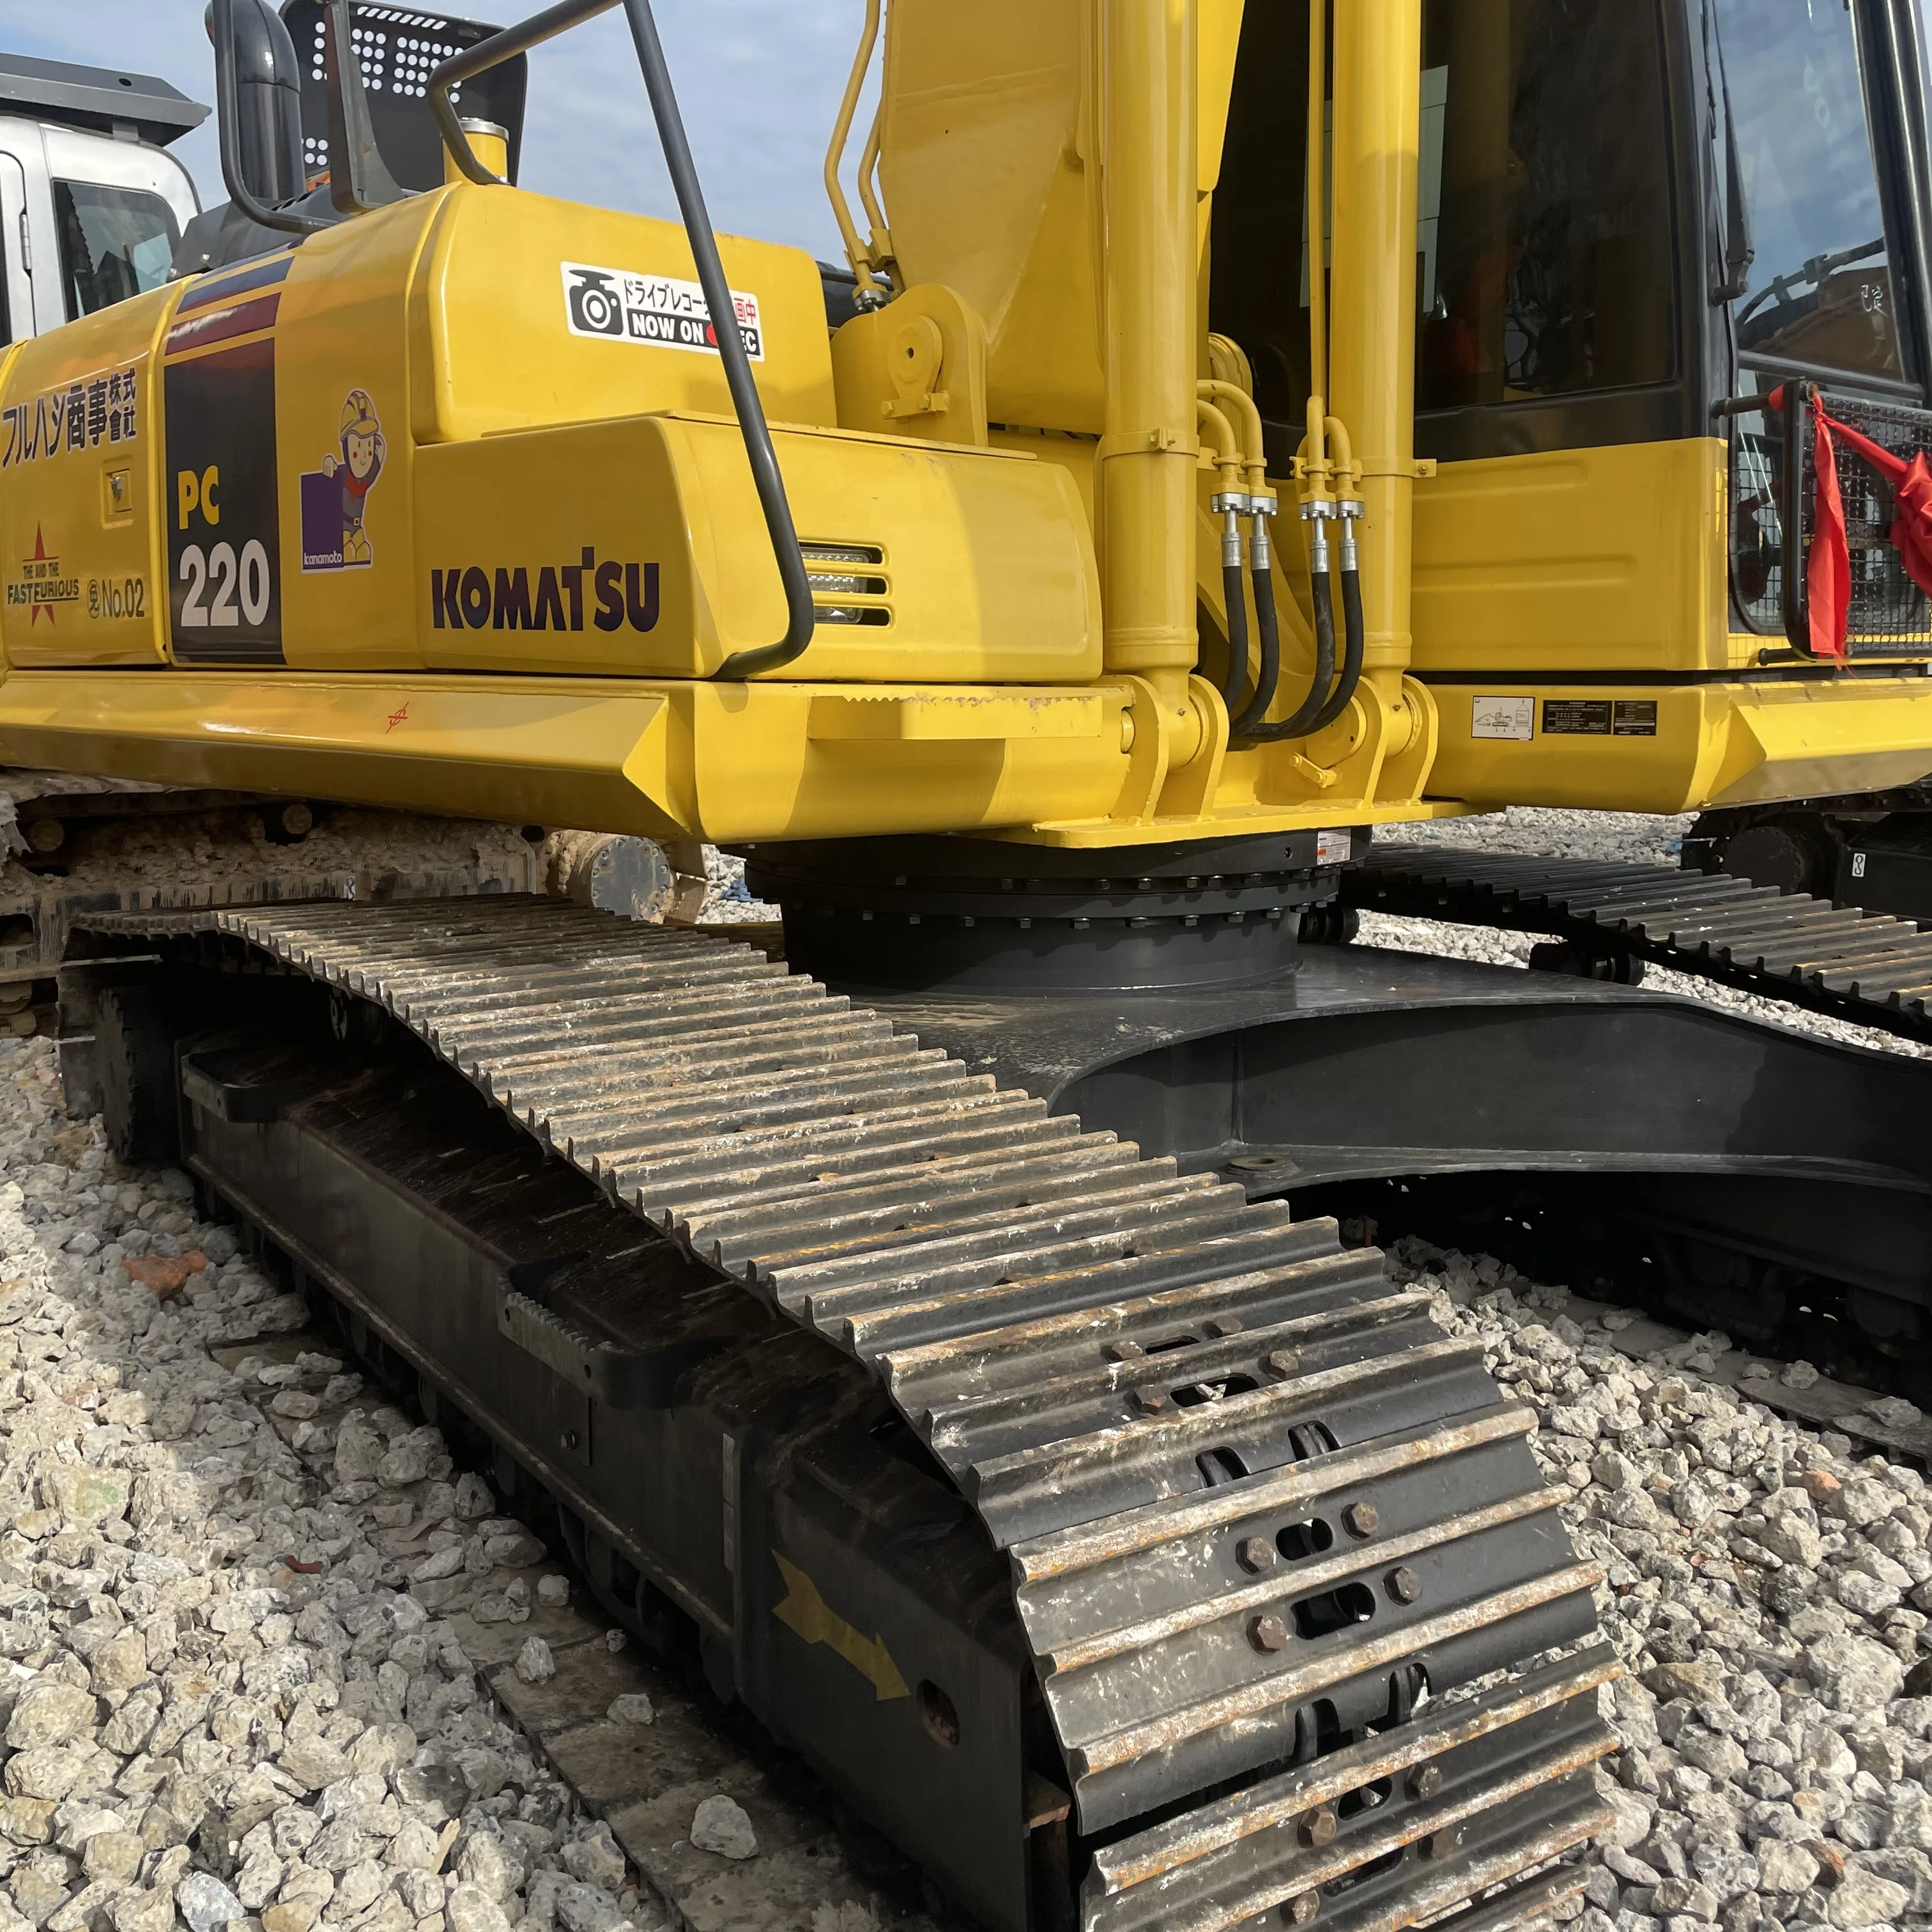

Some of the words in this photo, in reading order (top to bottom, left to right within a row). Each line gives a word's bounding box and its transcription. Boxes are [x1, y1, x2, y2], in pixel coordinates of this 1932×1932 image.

[631, 312, 675, 340] NOW
[680, 320, 705, 344] ON
[3, 379, 107, 468] フルハシ商事
[177, 464, 220, 530] PC
[180, 539, 270, 627] 220
[303, 549, 342, 565] kanamoto
[8, 583, 33, 605] FAST
[34, 578, 79, 602] FURIOUS
[102, 578, 145, 618] No.02
[431, 546, 659, 632] KOMATSU
